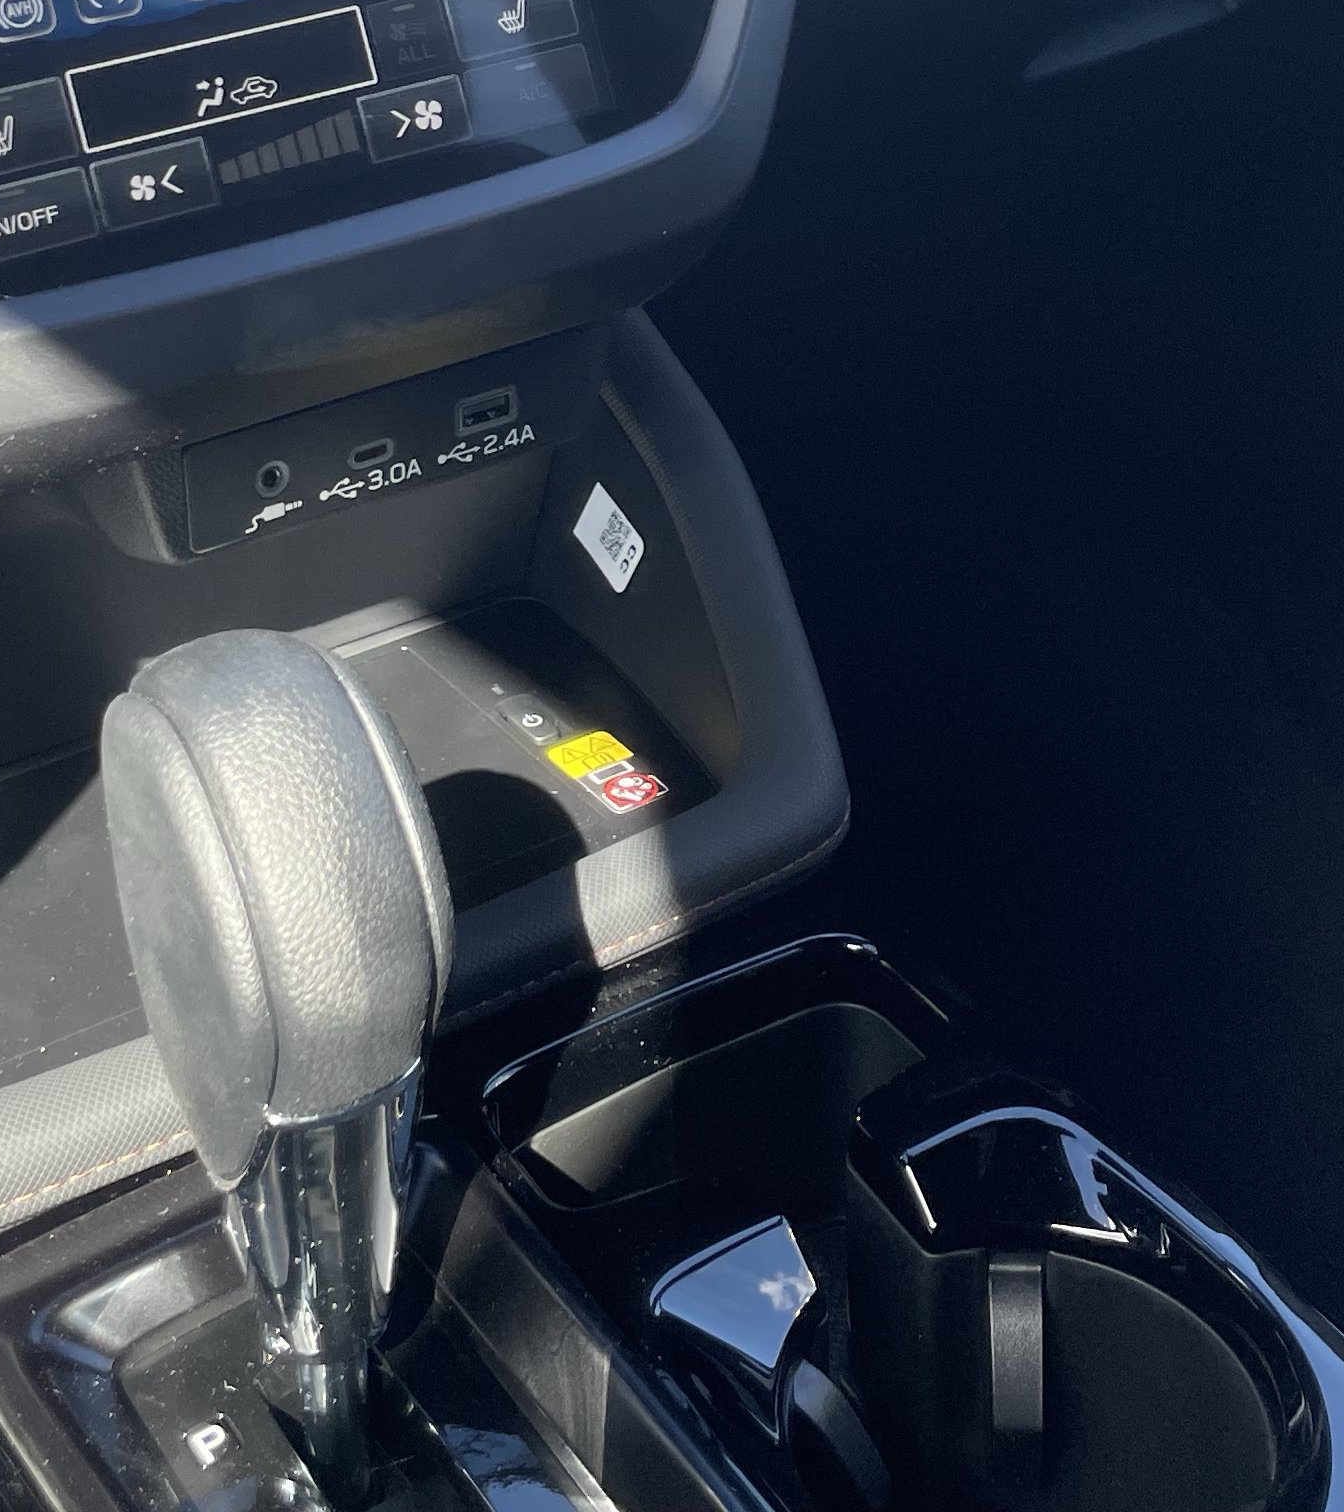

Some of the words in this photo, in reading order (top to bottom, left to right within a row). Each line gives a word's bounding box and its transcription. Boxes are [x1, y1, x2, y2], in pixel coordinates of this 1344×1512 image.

[7, 0, 33, 18] AVH
[397, 46, 436, 65] ALL
[518, 82, 551, 101] A/C
[482, 424, 536, 456] 2.4A
[367, 458, 422, 492] 3.0A
[187, 1423, 227, 1466] P
